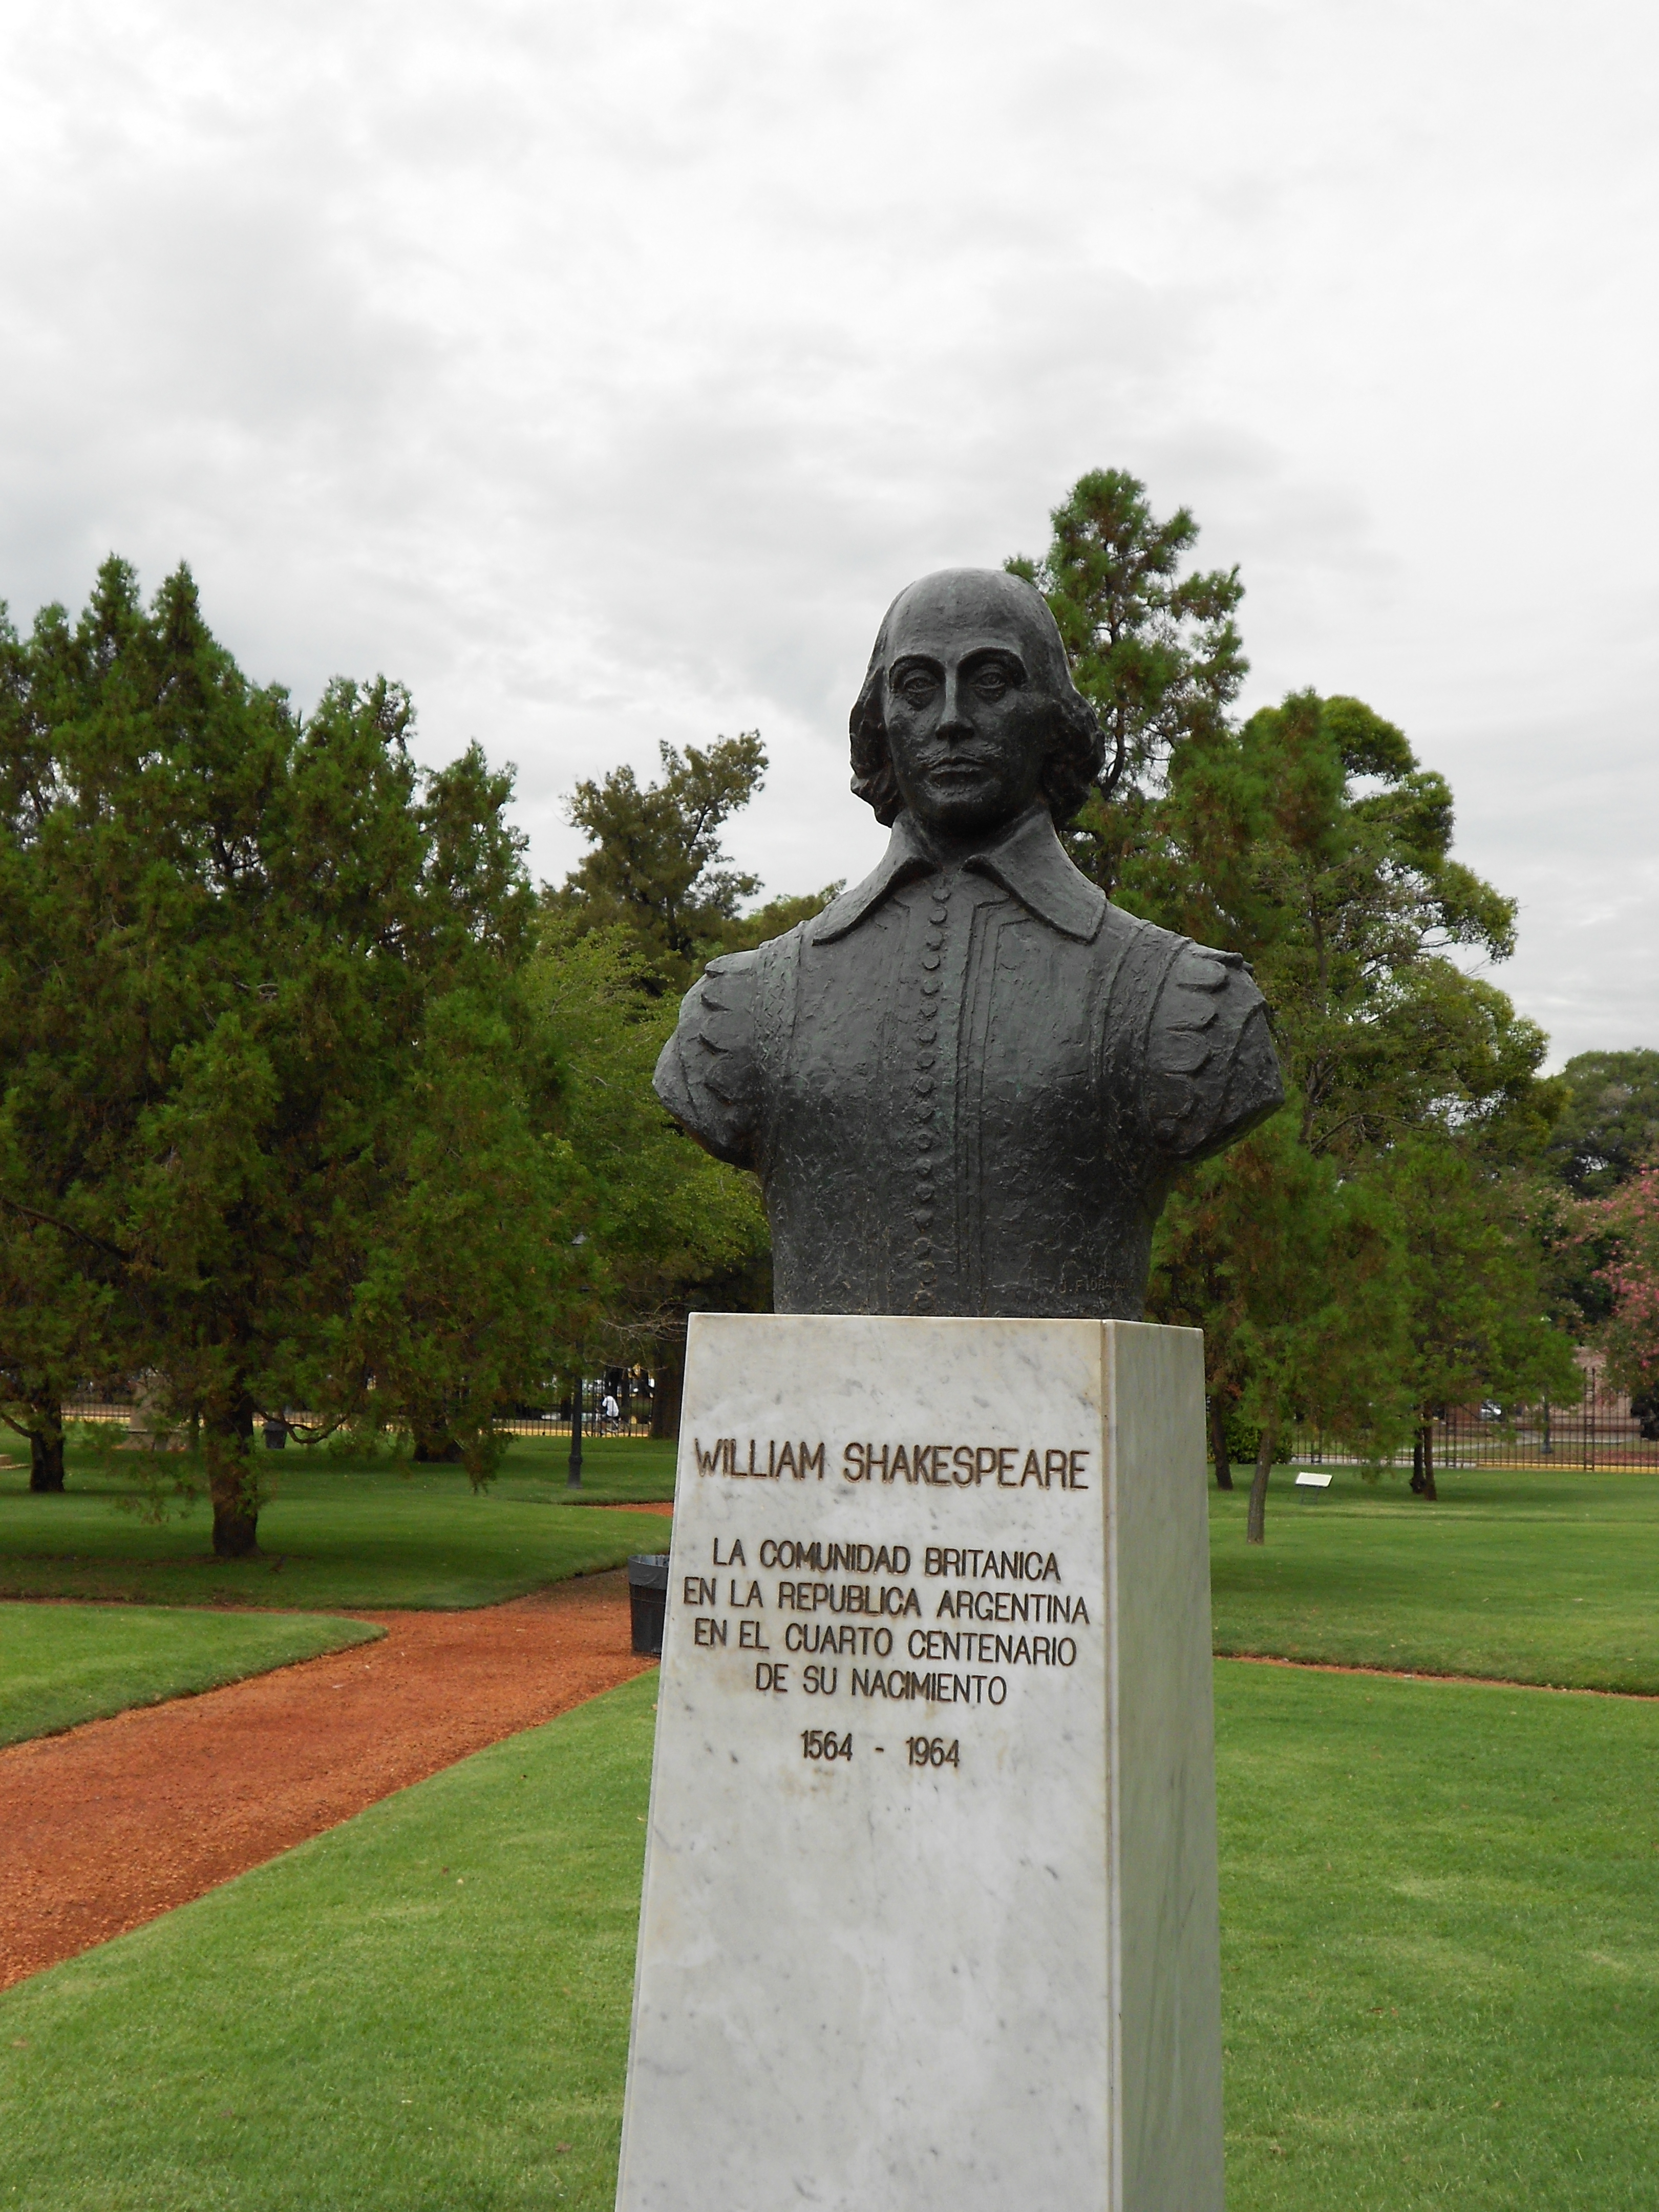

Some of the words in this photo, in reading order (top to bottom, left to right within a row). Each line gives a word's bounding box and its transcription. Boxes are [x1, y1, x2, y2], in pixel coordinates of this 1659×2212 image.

[694, 1438, 825, 1481] WILLIAM
[843, 1441, 1090, 1491] SHAKESPEARE
[713, 1537, 746, 1567] LA
[760, 1539, 911, 1576] COMUNIDAD
[924, 1547, 1061, 1583] BRITANICA
[684, 1576, 716, 1606] EN
[730, 1579, 763, 1608] LA
[778, 1581, 922, 1619] REPUBLICA
[936, 1589, 1091, 1625] ARGENTINA
[694, 1617, 728, 1647] EN
[739, 1620, 770, 1650] EL
[785, 1622, 893, 1657] CUARTO
[907, 1629, 1077, 1667] CENTENARIO
[755, 1662, 789, 1692] DE
[803, 1665, 837, 1695] SU
[851, 1667, 1008, 1706] NACIMIENTO
[800, 1729, 854, 1761] 1564
[906, 1736, 961, 1768] 1964
